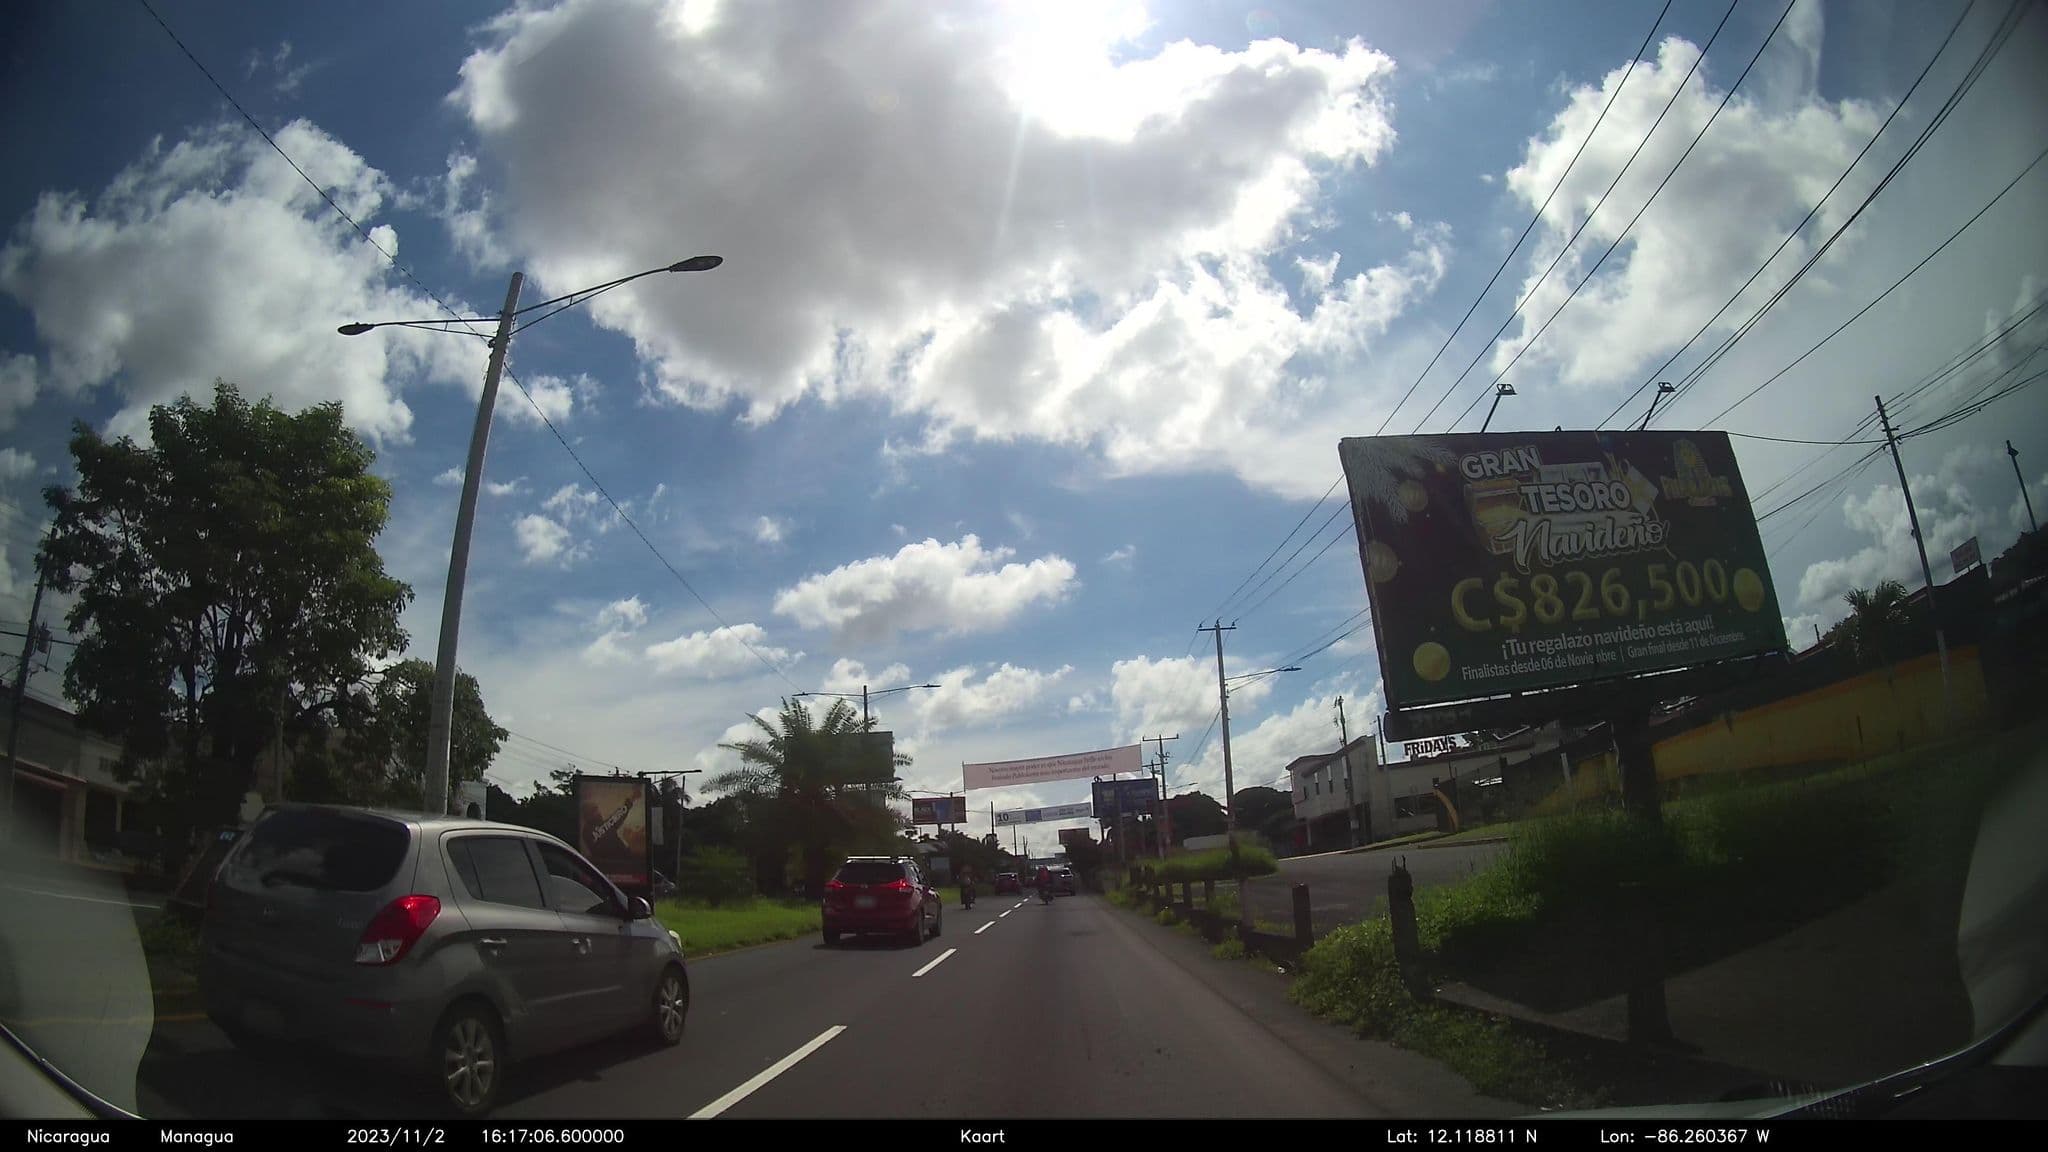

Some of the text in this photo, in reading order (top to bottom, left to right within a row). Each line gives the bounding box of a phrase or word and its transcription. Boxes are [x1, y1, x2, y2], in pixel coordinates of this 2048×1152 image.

[1460, 447, 1541, 480] GRAN
[1520, 481, 1631, 514] TESORO
[1495, 516, 1671, 571] Navideño
[1451, 557, 1729, 634] C$826,500
[1529, 633, 1592, 655] regalazo
[1594, 624, 1656, 646] navideño
[1628, 645, 1648, 659] Gran
[1461, 663, 1511, 680] Finalistas
[1511, 658, 1541, 674] desde
[1541, 657, 1553, 671] 06
[1555, 656, 1568, 669] de
